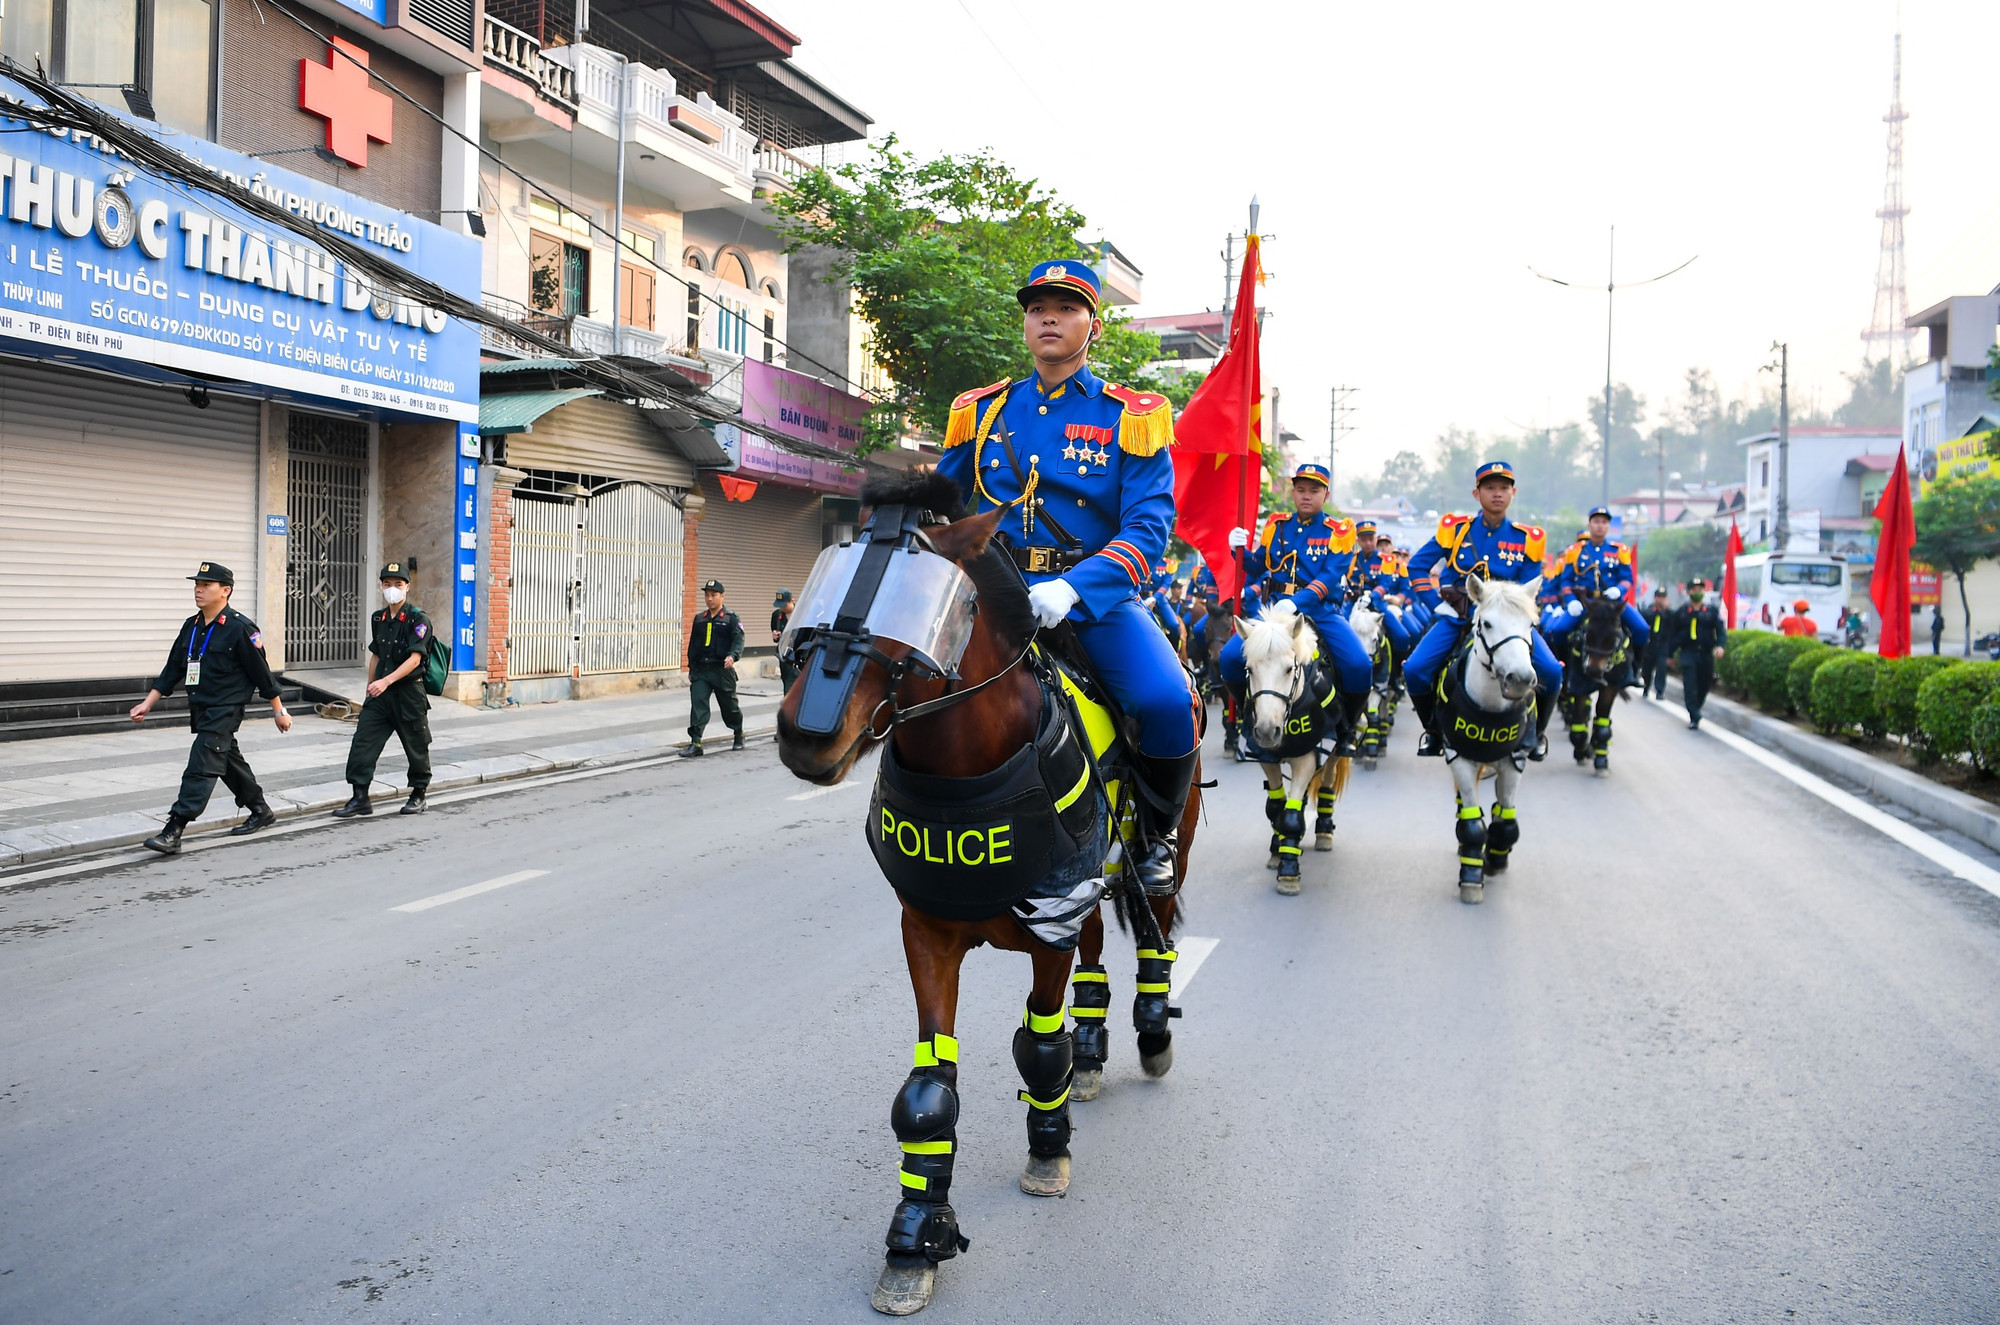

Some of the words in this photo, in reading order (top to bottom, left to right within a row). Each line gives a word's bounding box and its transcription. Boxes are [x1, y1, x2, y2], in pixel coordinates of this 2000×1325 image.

[0, 153, 168, 260] THUỐC
[180, 210, 335, 305] THANH
[286, 192, 365, 239] PHƯƠNG
[366, 219, 413, 254] THẢO
[3, 280, 34, 302] THÙY
[36, 290, 63, 310] LINH
[30, 247, 63, 276] LẺ
[76, 260, 168, 300] THUỐC
[199, 292, 264, 323] DỤNG
[272, 310, 301, 336] CỤ
[309, 318, 349, 344] VẬT
[356, 330, 381, 351] TƯ
[388, 338, 400, 355] Y
[407, 339, 428, 363] TẾ
[29, 321, 42, 335] TP.
[47, 324, 71, 342] ĐIỆN
[76, 330, 99, 346] BIÊN
[104, 335, 123, 351] PHỦ
[90, 298, 114, 319] SỐ
[117, 307, 148, 328] GCN
[243, 333, 262, 353] SỞ
[265, 339, 275, 355] Y
[277, 340, 294, 360] TẾ
[295, 346, 321, 367] ĐIỆN
[323, 353, 349, 371] BIÊN
[350, 356, 373, 376] CẤP
[375, 364, 402, 382] NGÀY
[404, 371, 455, 394] 31/12/2020
[340, 384, 351, 395] ĐT:
[353, 386, 369, 398] 0215
[372, 390, 387, 401] 3824
[409, 396, 424, 409] 0916
[425, 400, 437, 411] 820
[438, 402, 449, 413] 875
[780, 407, 801, 426] BÁN
[803, 414, 829, 434] BUÔN
[838, 424, 856, 442] BÁN
[1454, 716, 1519, 743] POLICE
[881, 806, 1012, 866] POLICE
